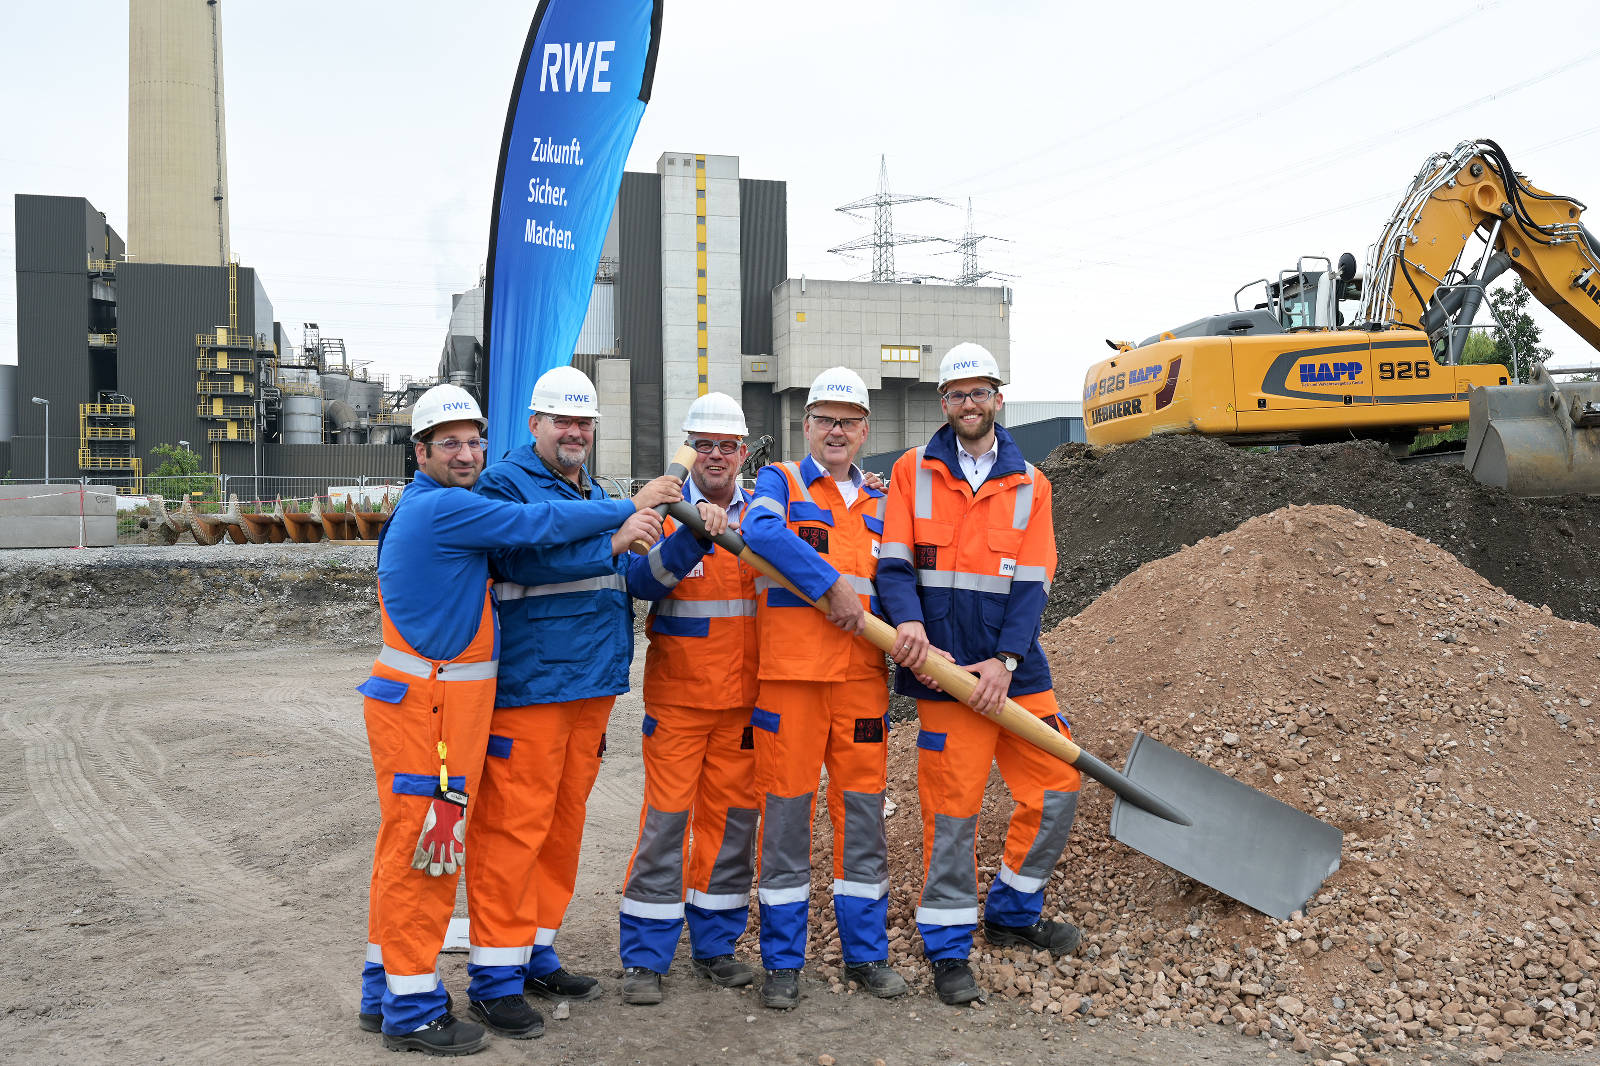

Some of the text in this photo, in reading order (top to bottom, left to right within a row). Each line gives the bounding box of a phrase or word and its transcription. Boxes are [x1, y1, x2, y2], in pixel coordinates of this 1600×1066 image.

[539, 40, 616, 92] RWE
[531, 137, 584, 165] Zukunft.
[527, 178, 567, 207] Sicher.
[524, 218, 575, 250] Machen.
[953, 360, 980, 370] RWE
[1379, 360, 1430, 381] 926
[826, 384, 853, 393] RWE
[1099, 372, 1125, 397] 926
[442, 401, 471, 411] RWE
[564, 394, 590, 403] RWE
[1091, 398, 1143, 425] LIEBHERR
